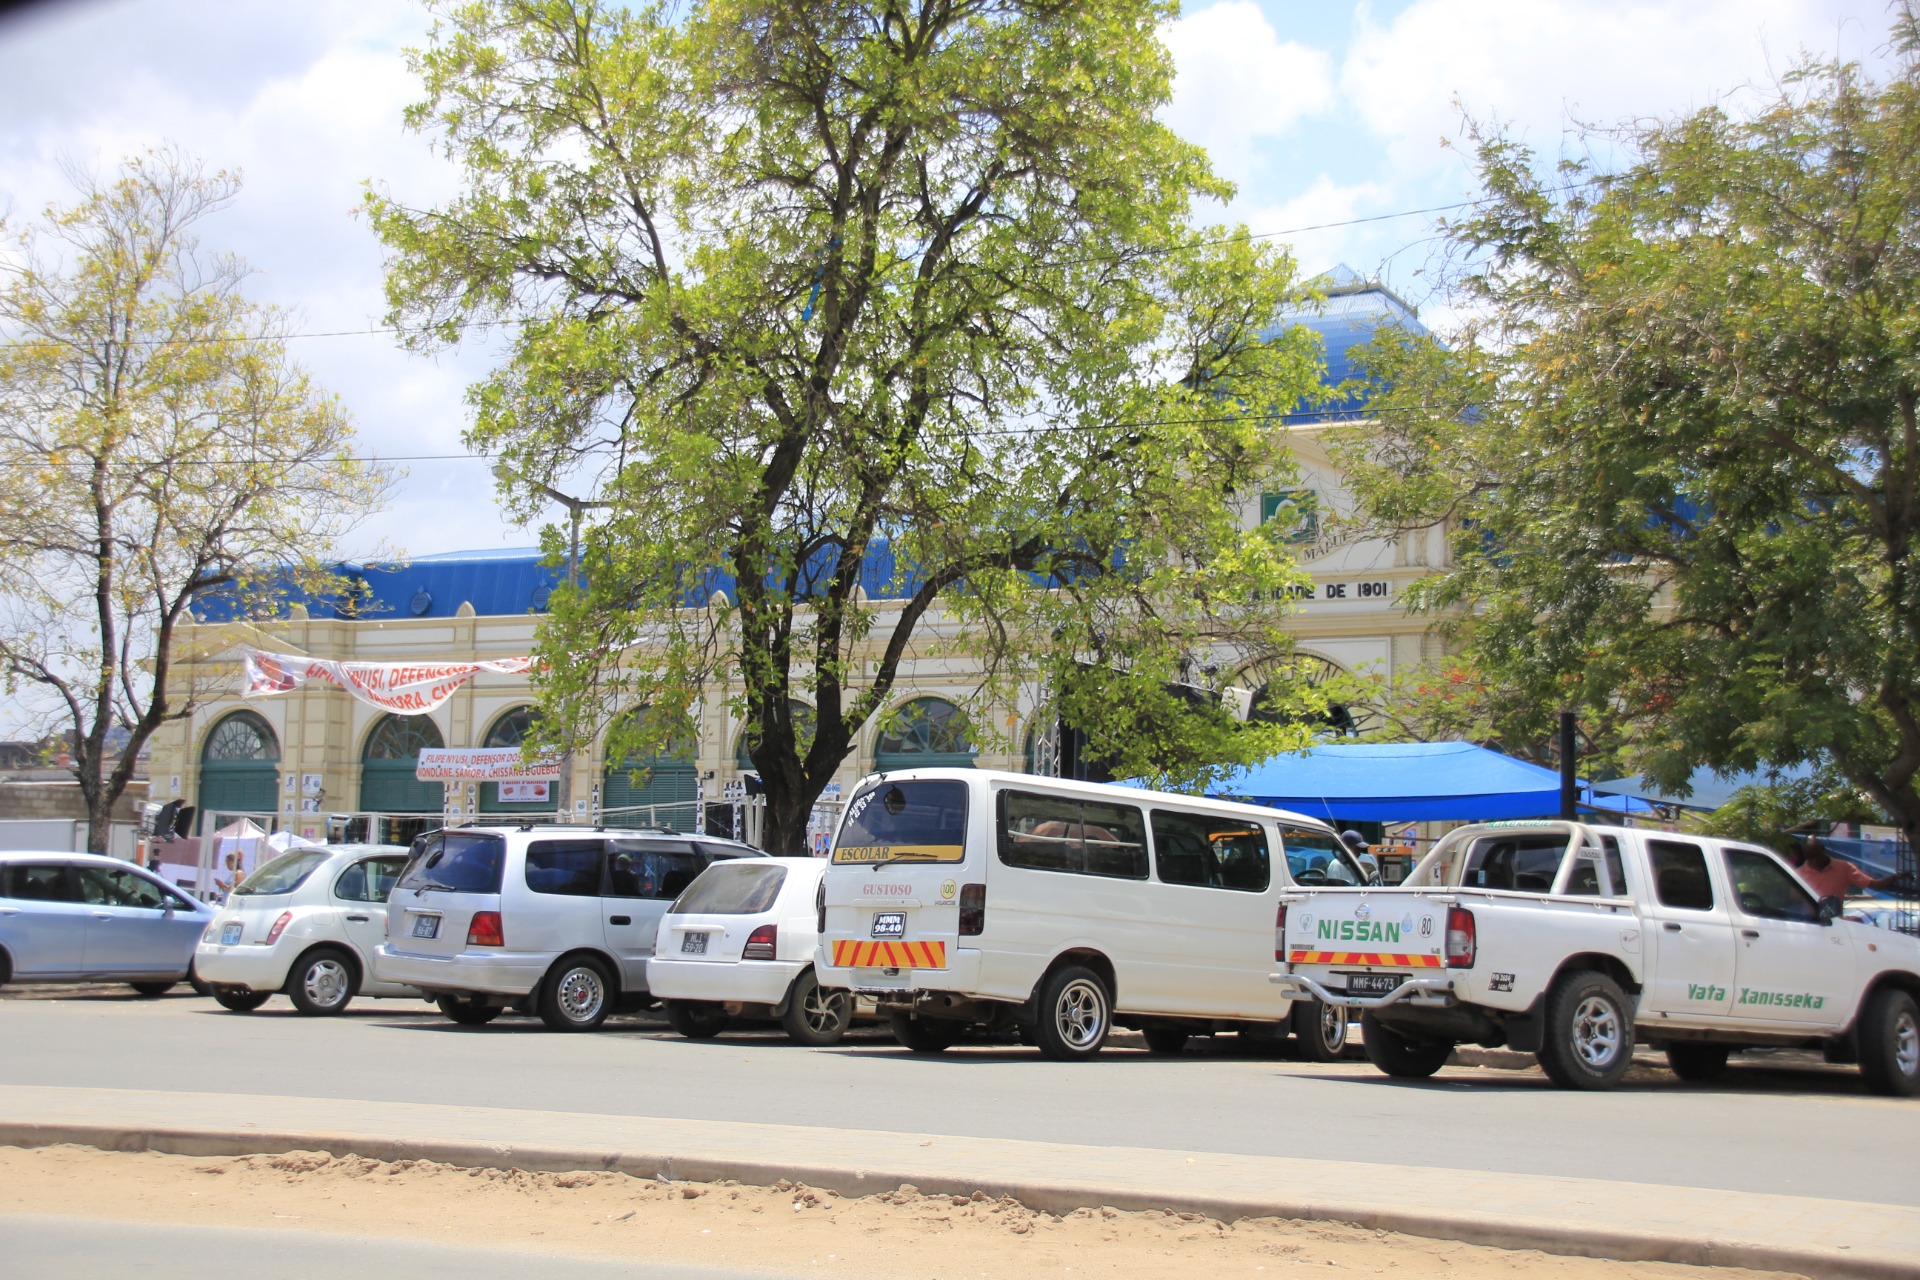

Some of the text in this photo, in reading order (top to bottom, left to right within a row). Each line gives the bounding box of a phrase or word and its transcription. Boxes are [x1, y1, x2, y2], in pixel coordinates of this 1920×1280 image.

[1326, 584, 1346, 599] DE
[1358, 582, 1387, 597] 1901
[471, 754, 506, 764] DEFENSOR
[841, 847, 889, 860] ESCOLAR
[863, 884, 912, 896] GUSTOSO
[942, 884, 955, 894] 100
[879, 915, 900, 924] MMM
[875, 924, 901, 933] 98-40
[1317, 919, 1400, 943] NISSAN
[1421, 917, 1432, 936] 80
[684, 943, 703, 953] 59-20
[1352, 977, 1394, 990] MMF-44-73
[1688, 984, 1824, 1009] Vata Xanisseka
